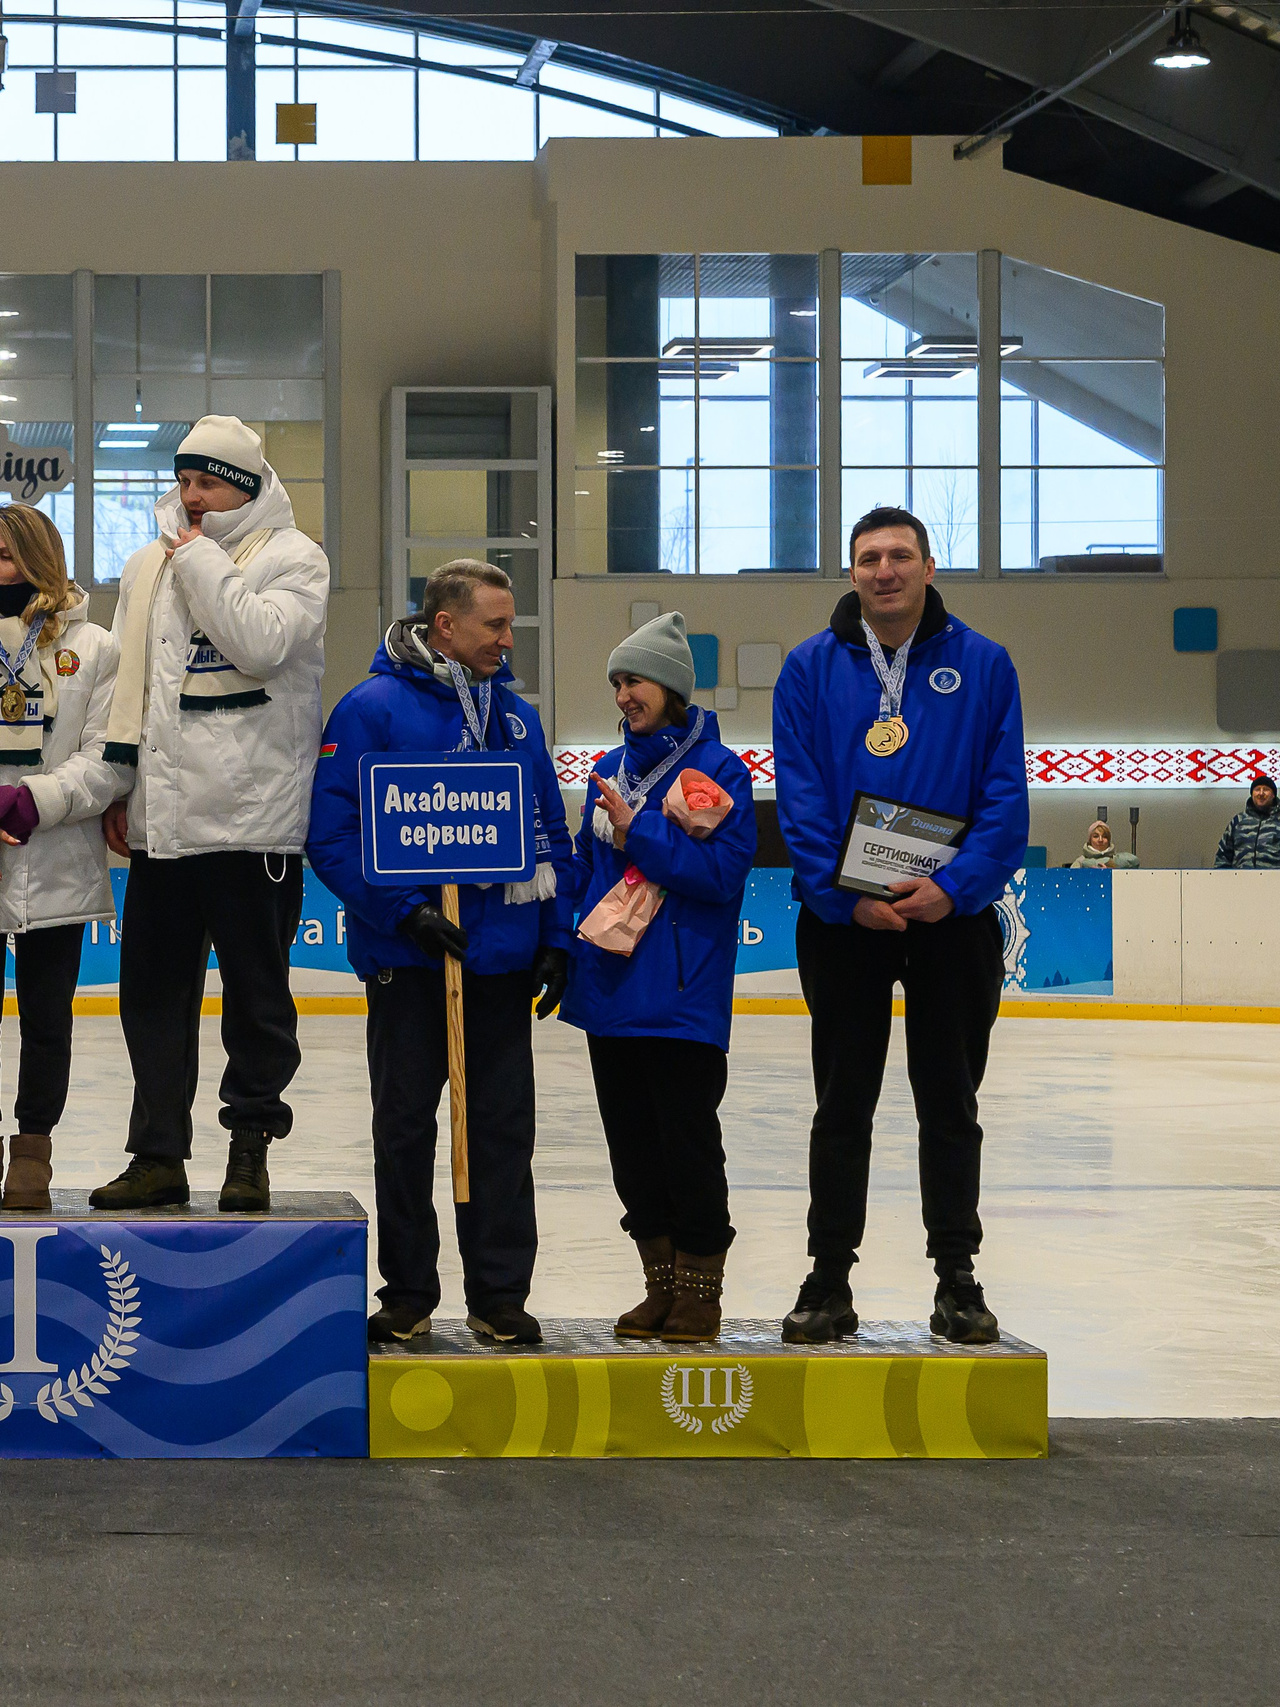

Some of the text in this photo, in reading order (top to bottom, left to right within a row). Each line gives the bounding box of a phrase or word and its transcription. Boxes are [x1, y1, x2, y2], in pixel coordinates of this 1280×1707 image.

[207, 462, 255, 488] БЕЛАРУСЬ
[384, 781, 512, 814] Академия
[400, 822, 498, 854] сервиса
[862, 841, 941, 871] СЕРТИФИКАТ
[676, 1367, 739, 1408] III
